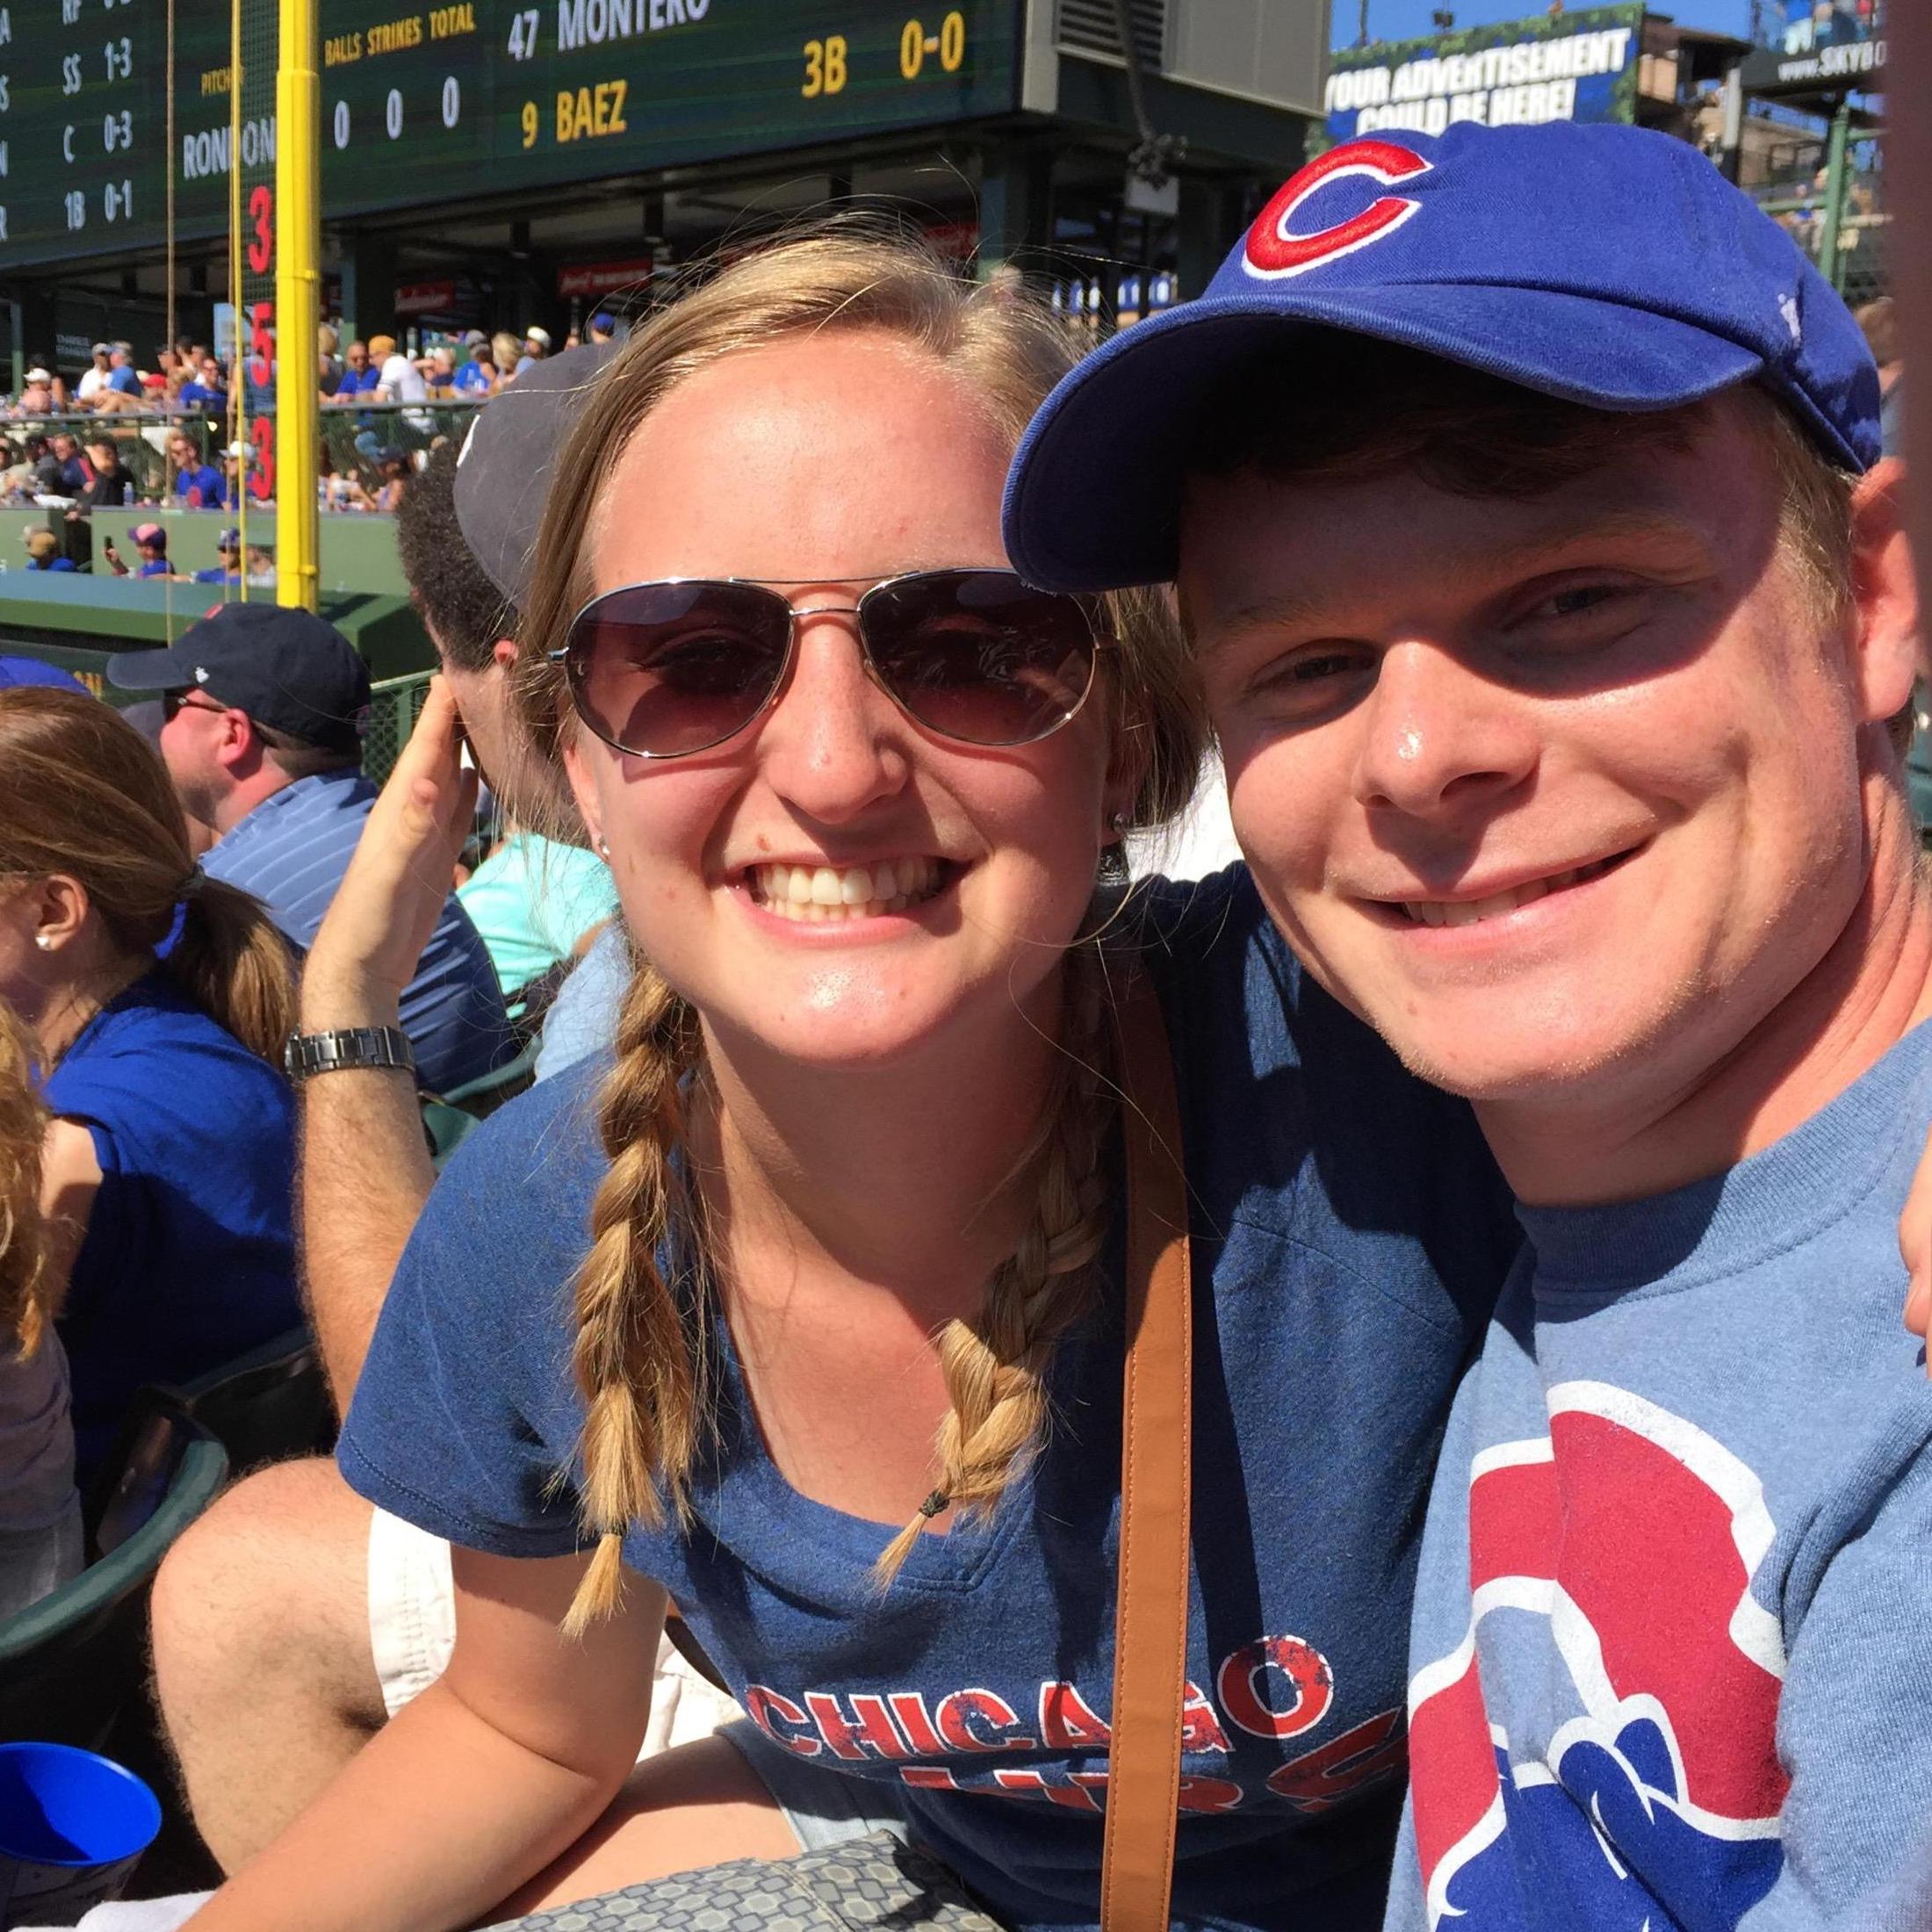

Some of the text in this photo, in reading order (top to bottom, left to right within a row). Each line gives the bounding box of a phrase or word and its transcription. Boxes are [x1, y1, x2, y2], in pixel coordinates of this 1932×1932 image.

[324, 3, 477, 68] BALLS STRIKES TOTAL
[508, 9, 539, 61] 47
[1391, 27, 1632, 103] ADVERTISEMENT
[62, 53, 82, 96] SS
[105, 36, 132, 83] 1-3
[200, 65, 244, 97] PITCH
[522, 11, 965, 149] 9 BAEZ 3B 0-0
[63, 125, 76, 163] C
[104, 110, 133, 154] 0-3
[334, 76, 460, 149] 0 0 0
[1356, 78, 1576, 138] COULD BE HERE!
[64, 191, 86, 230] 1B
[104, 179, 132, 222] 0-1
[1241, 140, 1435, 280] C
